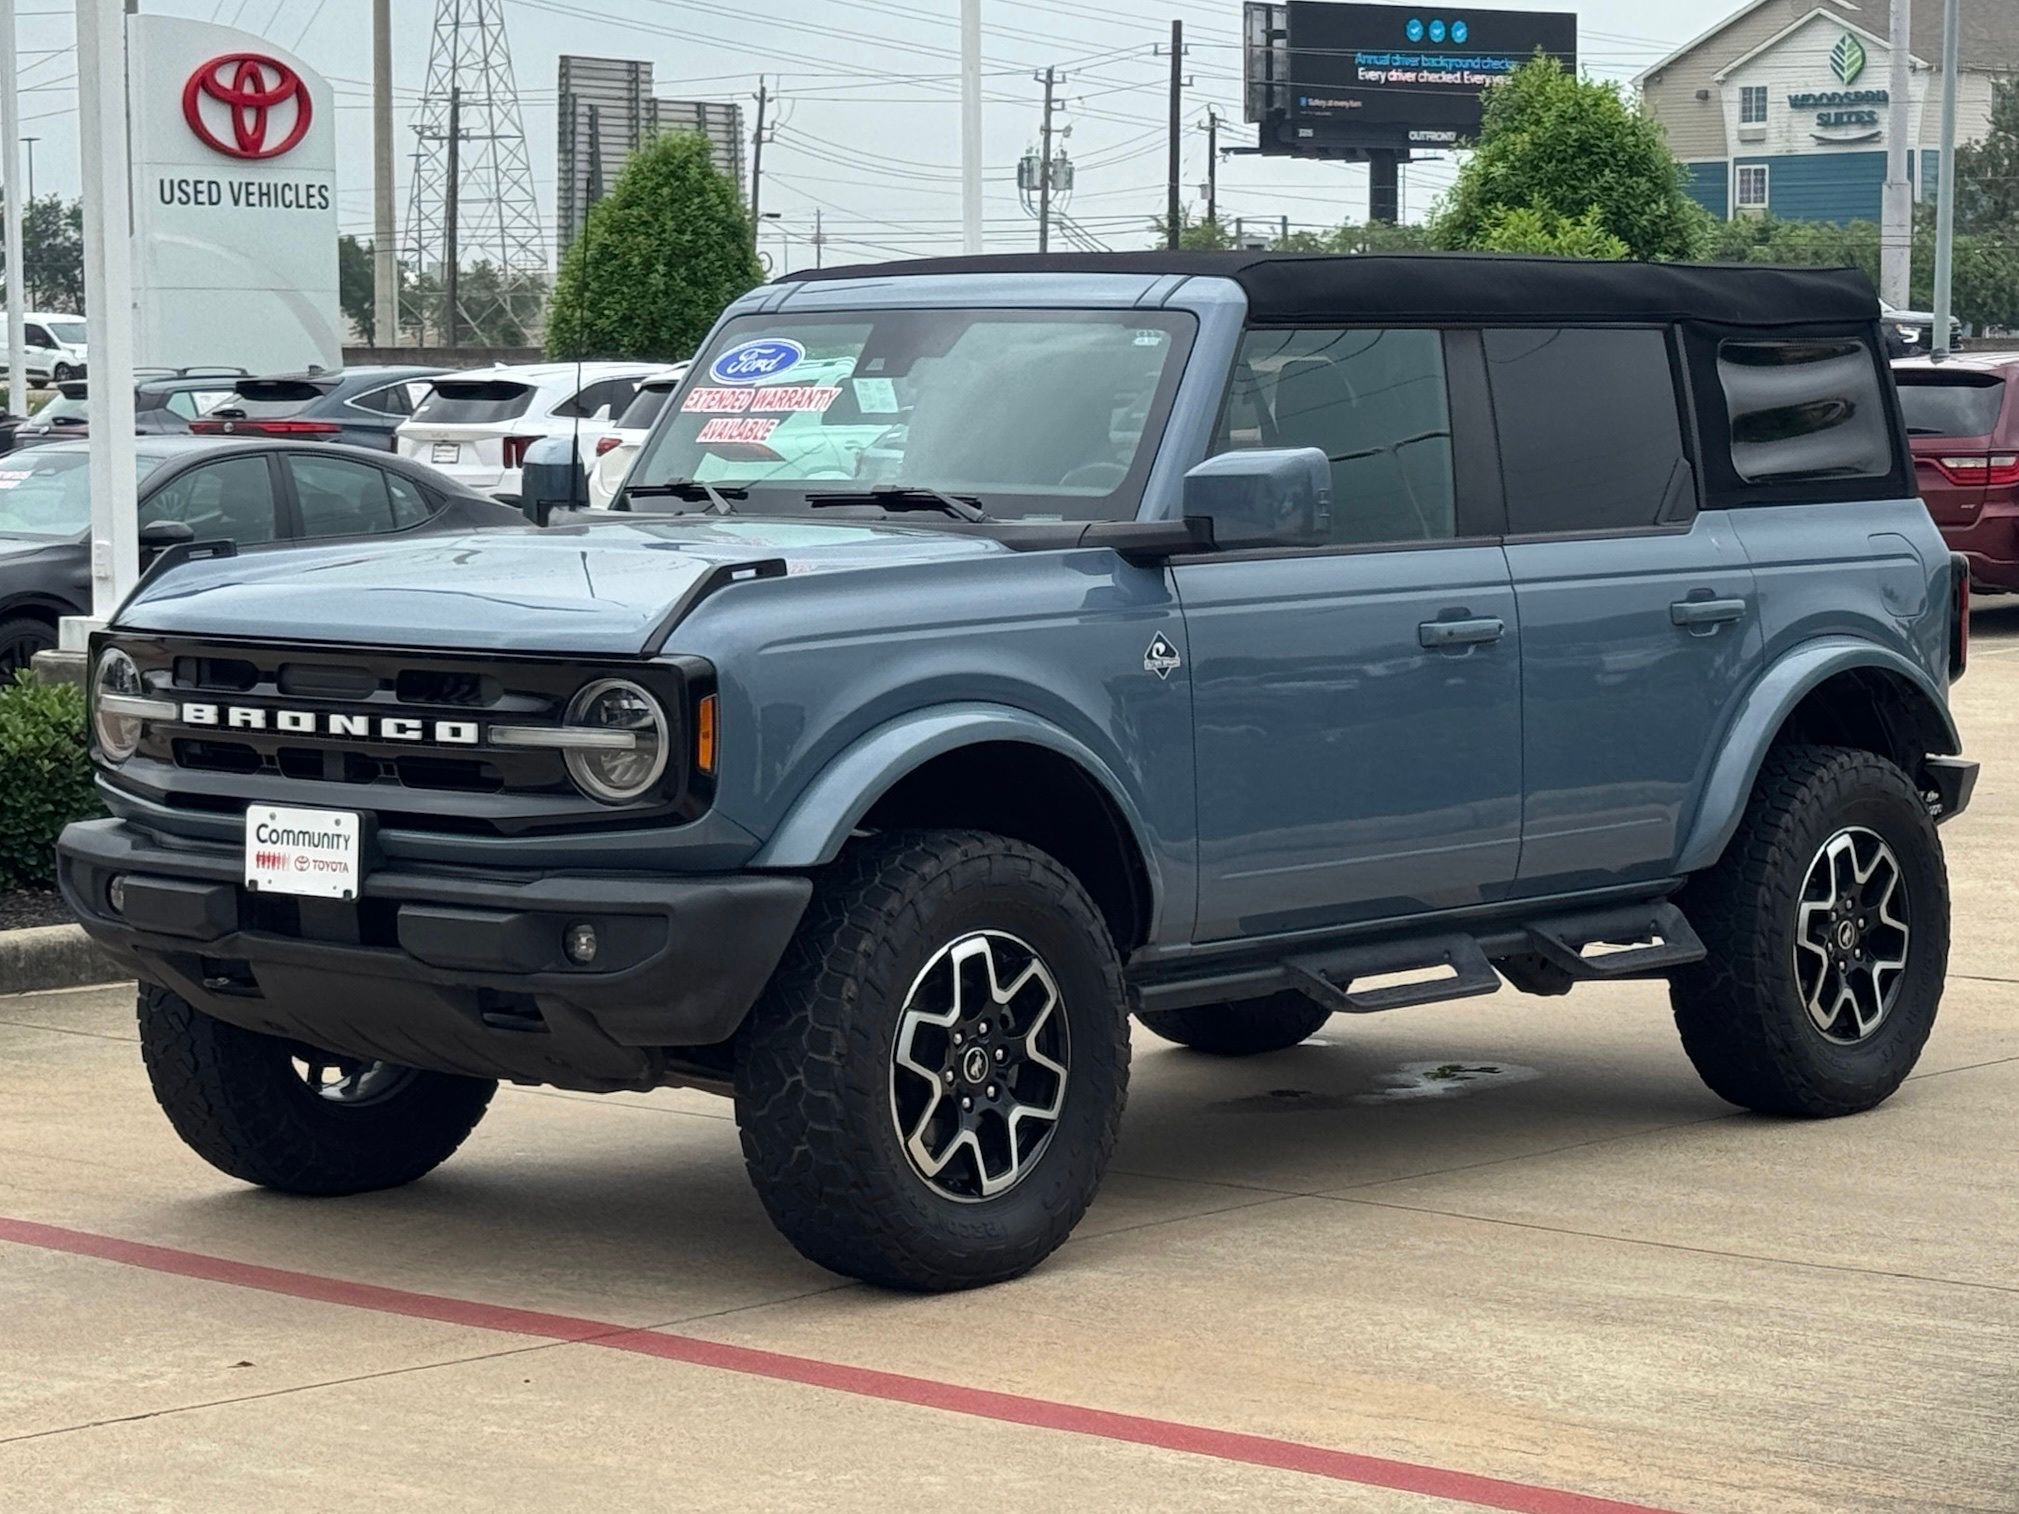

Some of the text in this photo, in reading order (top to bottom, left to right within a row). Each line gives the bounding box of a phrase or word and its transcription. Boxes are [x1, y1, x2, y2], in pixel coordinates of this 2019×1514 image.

[1355, 52, 1510, 70] Annual driver background check
[1358, 67, 1387, 84] Every
[1387, 69, 1417, 82] driver
[1463, 71, 1491, 87] Every
[1816, 110, 1879, 127] SUITES
[159, 178, 330, 210] USED VEHICLES
[726, 347, 787, 375] Ford
[684, 388, 752, 411] EXTENDED
[751, 388, 840, 410] WARRANTY
[701, 421, 777, 442] AVAILABLE
[182, 702, 479, 744] BRONCO
[312, 859, 350, 874] TOYOTA
